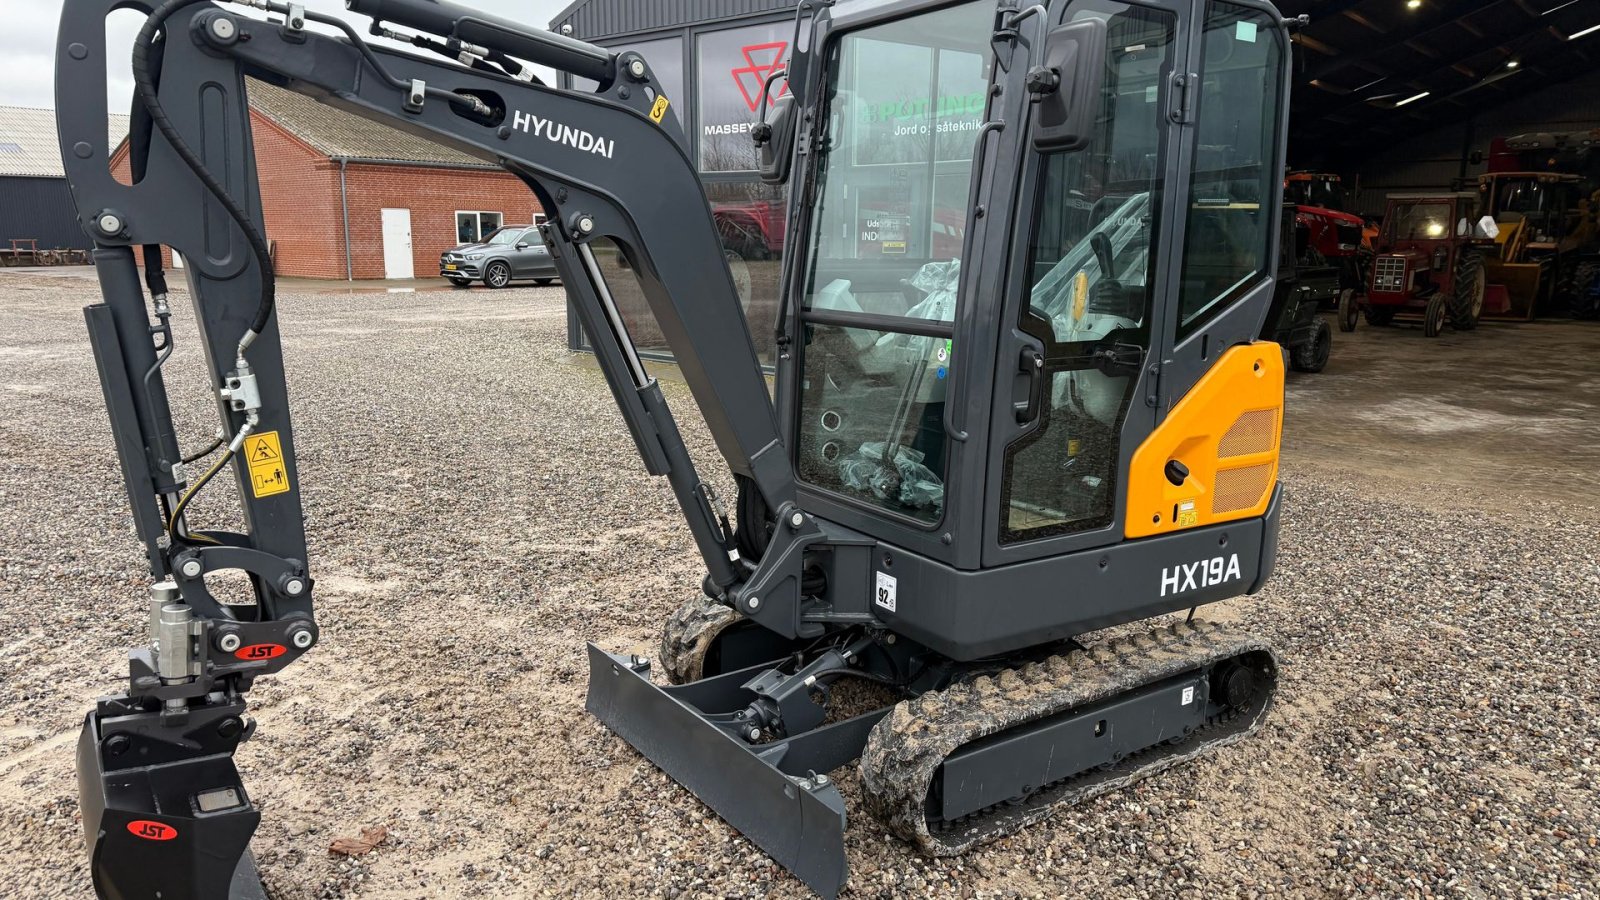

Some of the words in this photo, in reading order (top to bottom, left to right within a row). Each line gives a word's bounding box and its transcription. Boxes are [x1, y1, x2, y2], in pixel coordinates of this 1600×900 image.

[512, 109, 615, 160] HYUNDAI
[704, 122, 755, 136] MASSEY
[894, 124, 917, 136] Jord
[936, 119, 983, 133] såteknik
[1160, 553, 1241, 597] HX19A
[878, 586, 889, 605] 92
[247, 645, 275, 658] JST
[139, 823, 166, 839] JST
